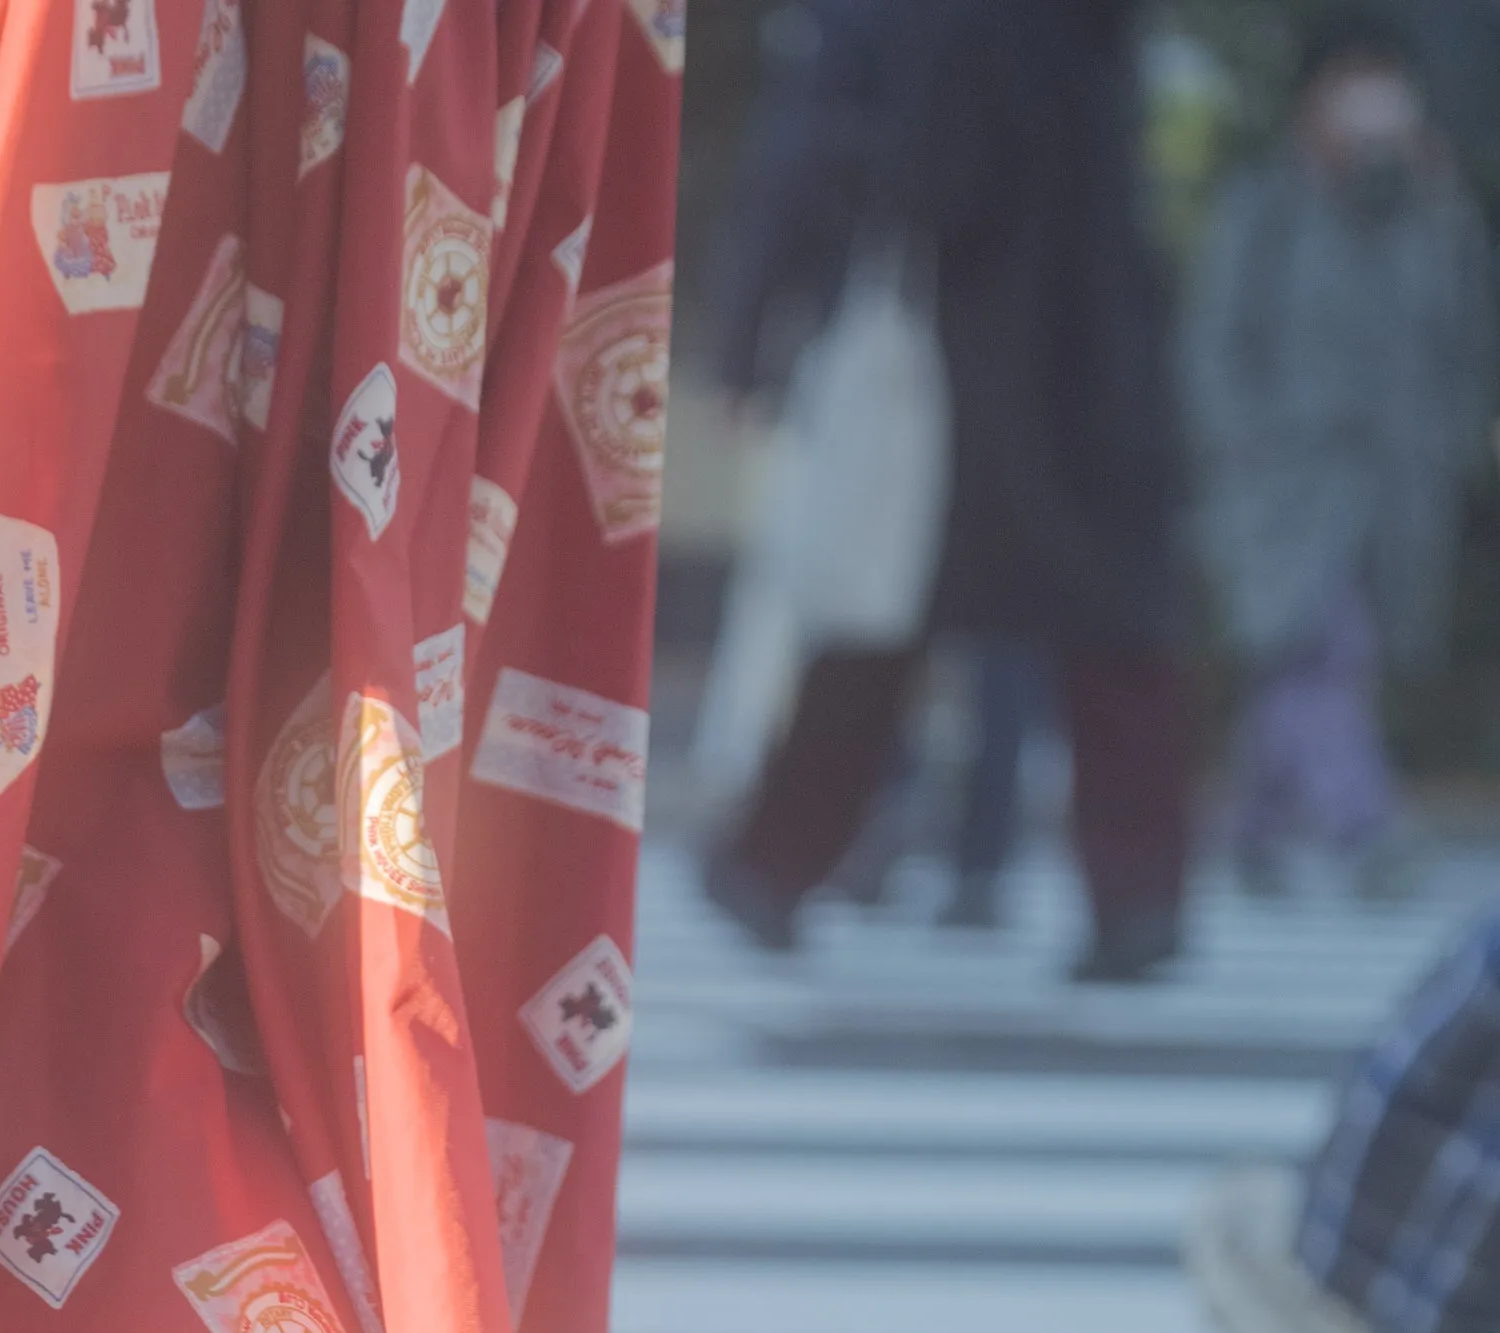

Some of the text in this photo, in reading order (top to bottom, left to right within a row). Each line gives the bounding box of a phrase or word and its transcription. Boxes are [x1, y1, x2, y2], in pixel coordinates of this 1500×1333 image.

[20, 549, 39, 625] LEAVE ME
[36, 557, 52, 608] ALONE
[64, 1207, 105, 1258] PINK
